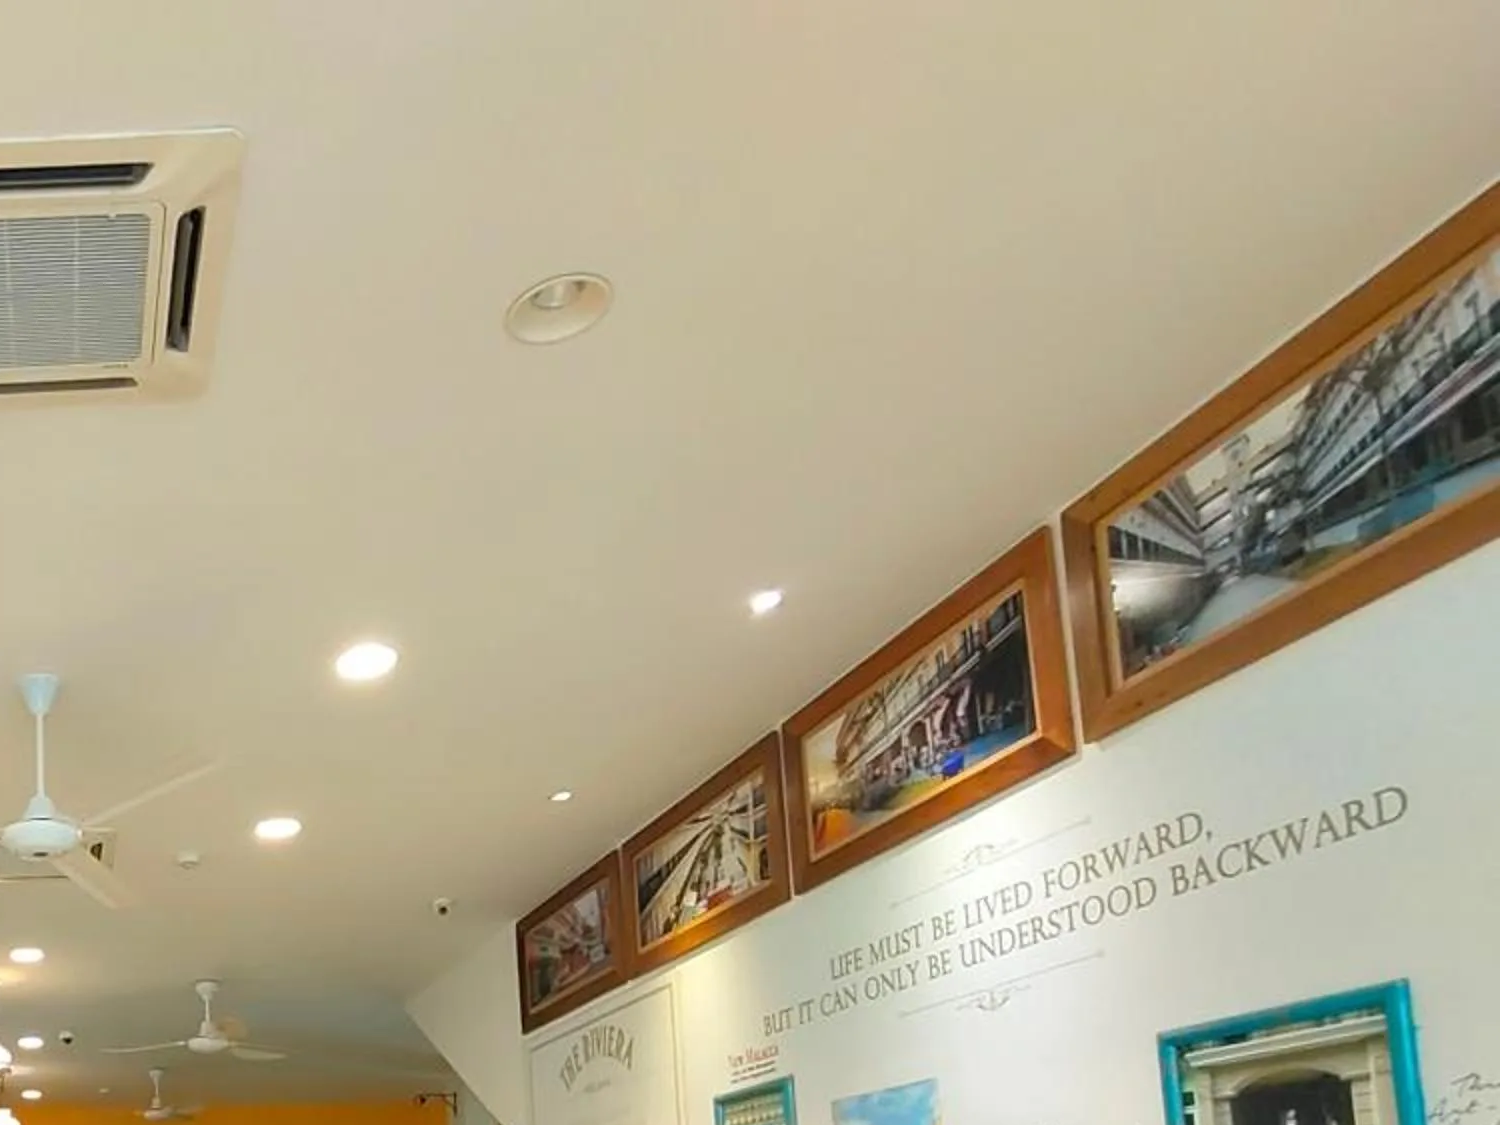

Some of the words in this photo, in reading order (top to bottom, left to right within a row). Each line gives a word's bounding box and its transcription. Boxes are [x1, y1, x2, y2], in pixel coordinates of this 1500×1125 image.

[763, 1007, 794, 1038] BUT
[799, 998, 815, 1025] IT
[819, 984, 858, 1017] CAN
[865, 960, 920, 1001] ONLY
[928, 950, 953, 981] BE
[959, 877, 1157, 968] UNDERSTOOD
[1172, 787, 1409, 897] BACKWARD
[830, 947, 865, 980] LIFE
[869, 922, 925, 965] MUST
[931, 910, 957, 941] BE
[962, 881, 1033, 929] LIVED
[1043, 811, 1213, 898] FORWARD,
[559, 1043, 583, 1092] THE
[582, 1025, 635, 1071] RIVIERA
